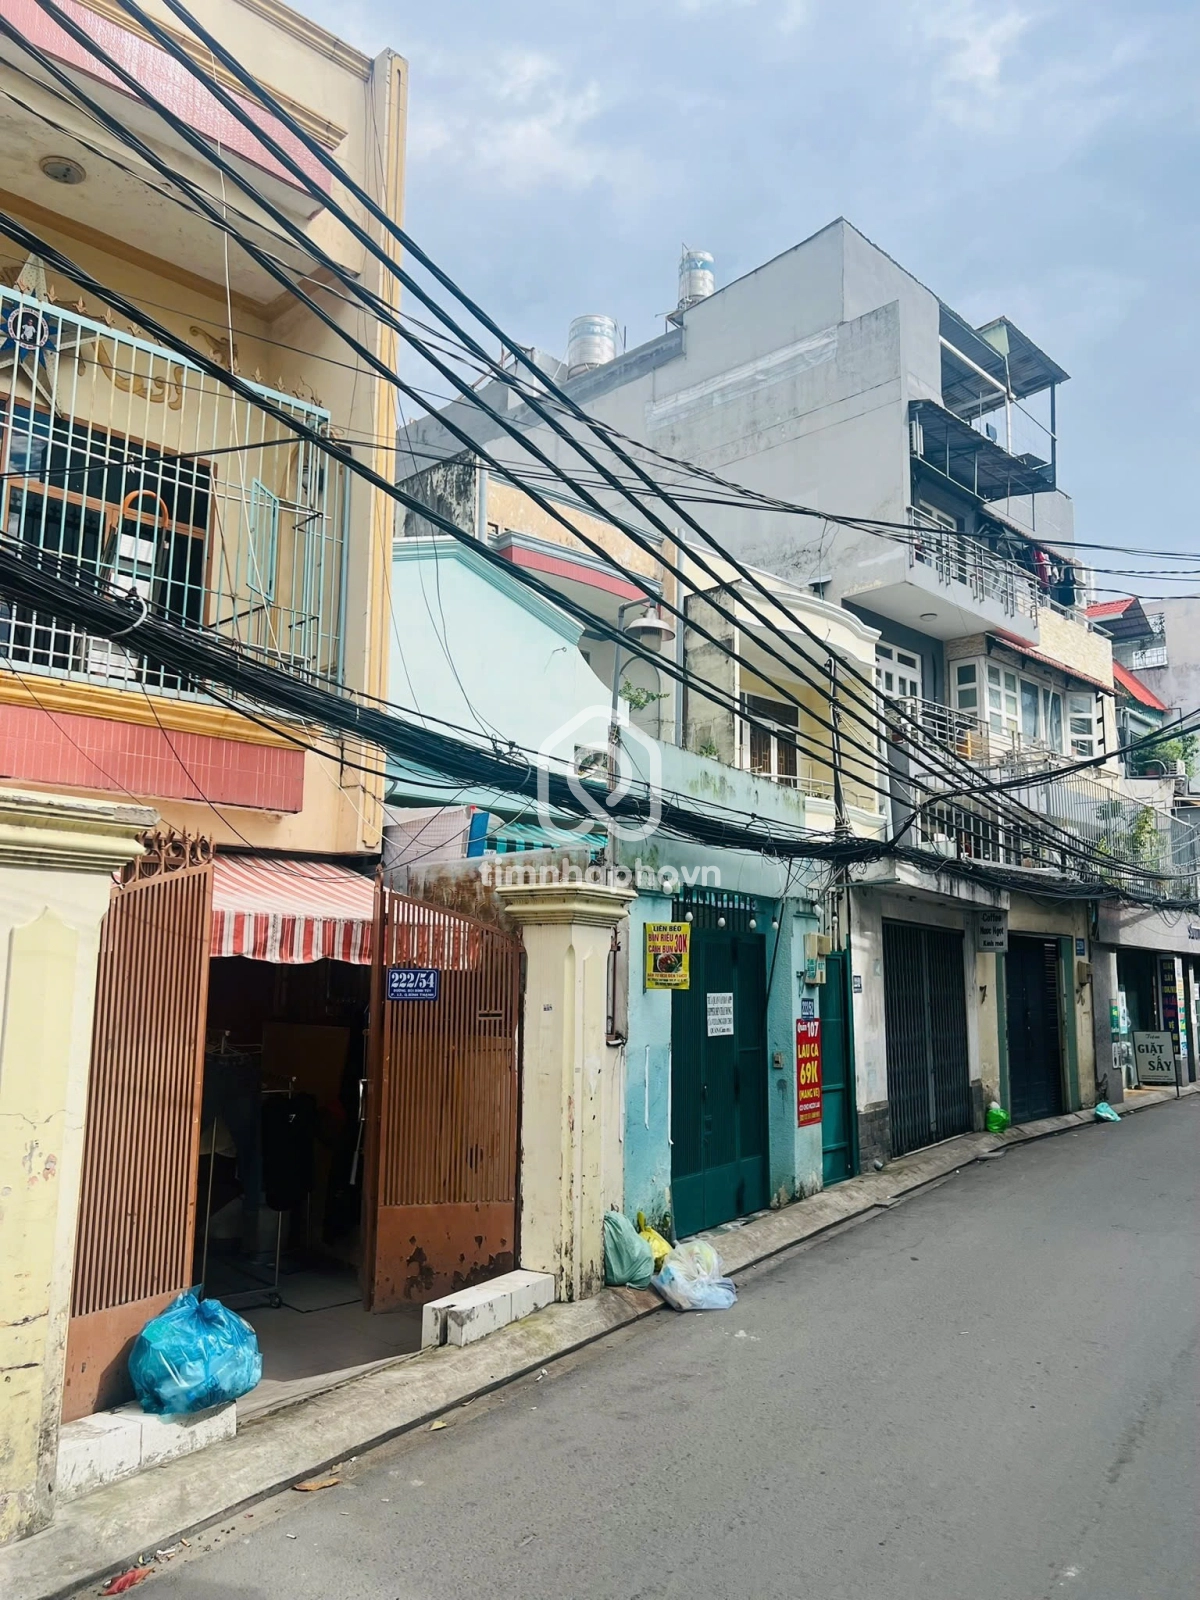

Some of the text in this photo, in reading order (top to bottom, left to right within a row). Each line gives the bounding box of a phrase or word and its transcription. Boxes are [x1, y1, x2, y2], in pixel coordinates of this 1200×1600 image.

[674, 934, 687, 953] 30K
[391, 972, 434, 988] 222/54
[808, 1021, 819, 1037] 107
[1137, 1042, 1164, 1056] GIẶT
[1148, 1056, 1172, 1071] SẤY
[800, 1061, 818, 1085] 69K
